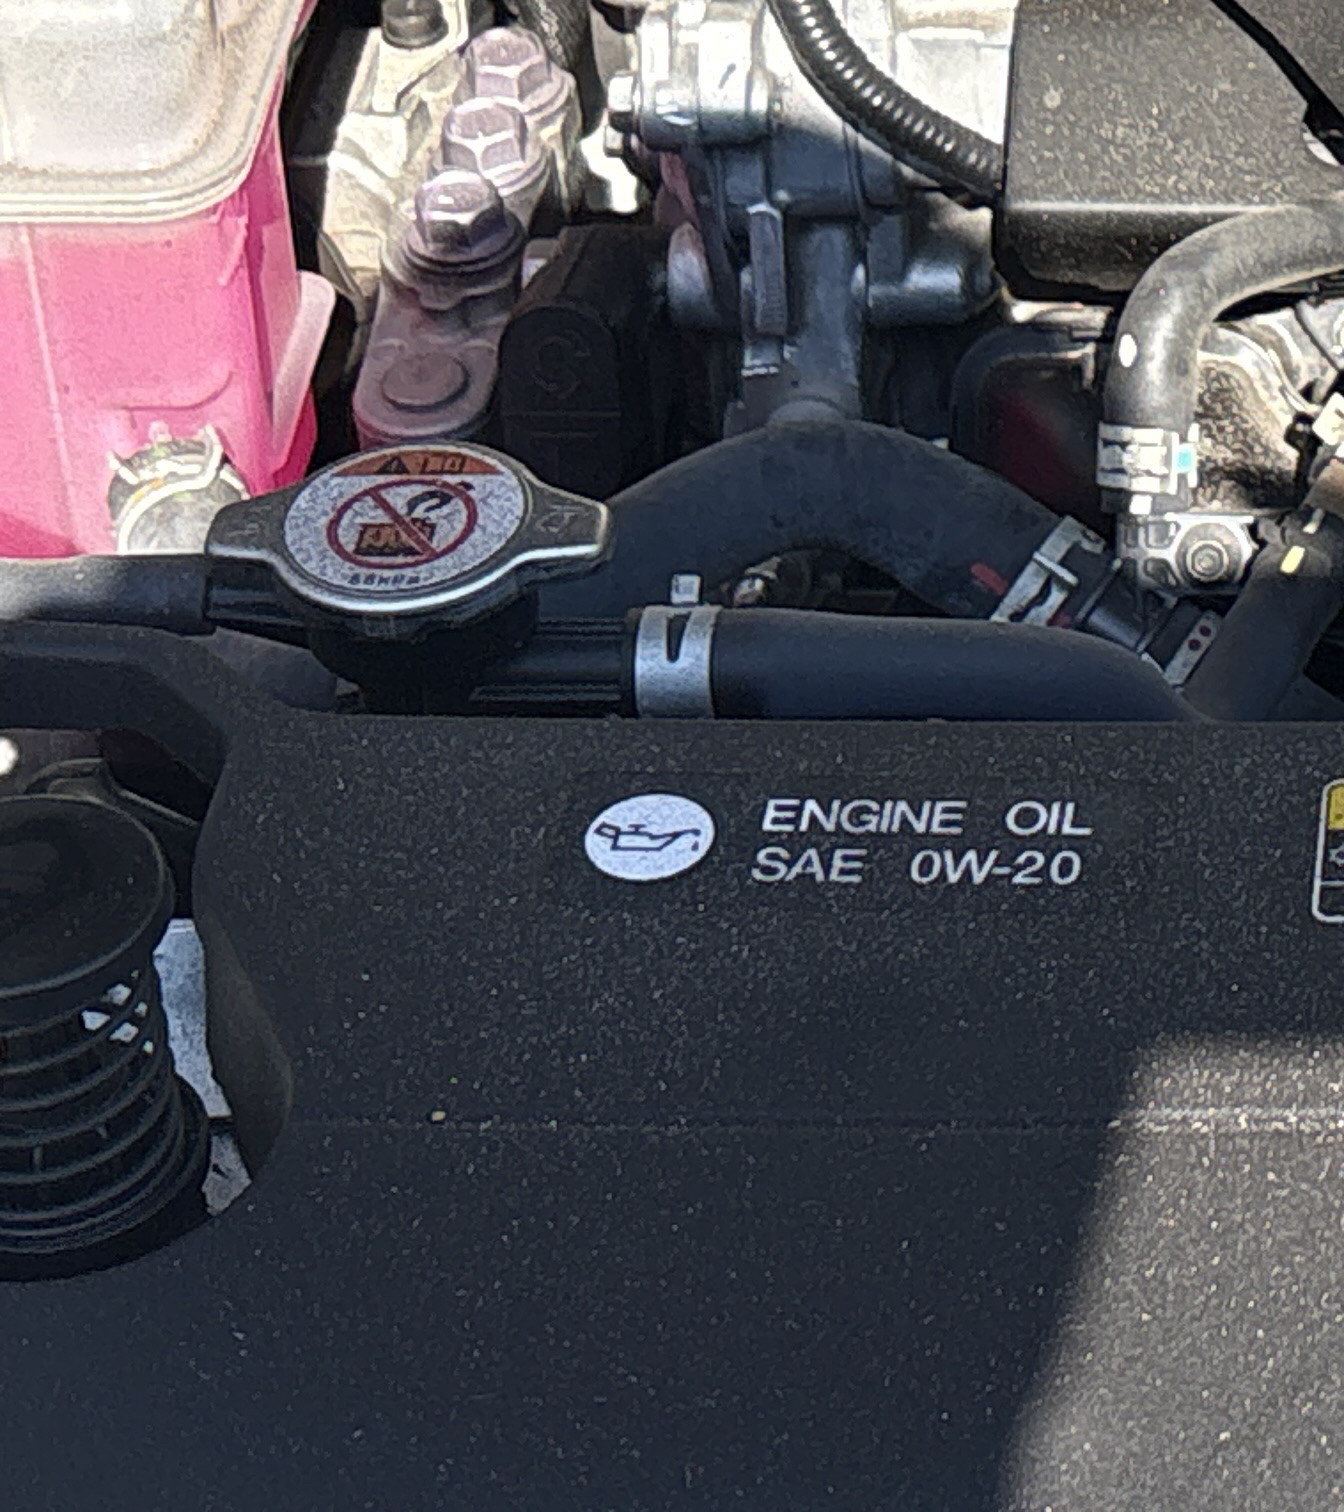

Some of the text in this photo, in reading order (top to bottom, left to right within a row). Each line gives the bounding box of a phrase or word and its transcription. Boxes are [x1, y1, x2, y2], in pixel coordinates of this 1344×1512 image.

[761, 798, 1094, 836] ENGINE OIL
[750, 846, 1082, 885] SAE 0W-20
